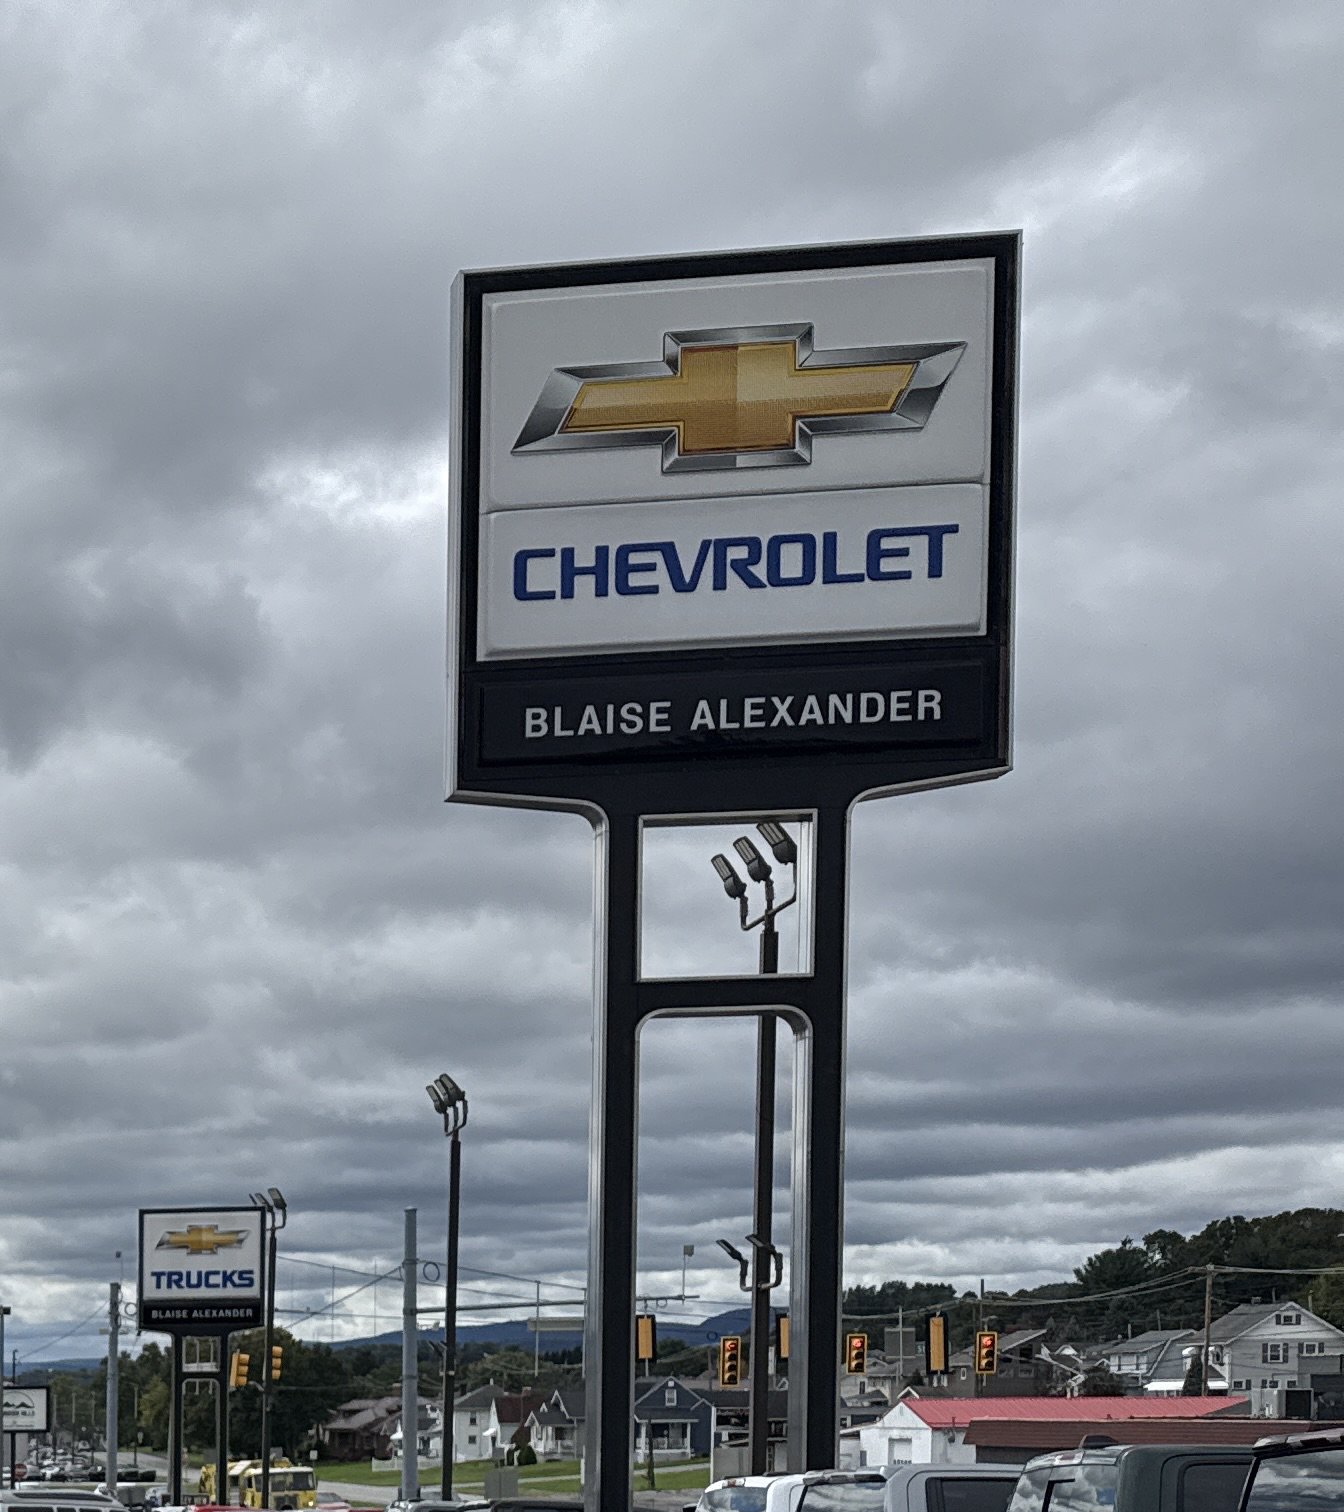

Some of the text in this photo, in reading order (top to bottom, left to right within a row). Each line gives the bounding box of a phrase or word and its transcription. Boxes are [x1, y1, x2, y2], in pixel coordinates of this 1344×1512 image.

[513, 524, 960, 601] CHEVROLET
[525, 689, 942, 738] BLAISE ALEXANDER
[151, 1270, 255, 1289] TRUCKS
[152, 1308, 253, 1319] BLAISE ALEXANDER
